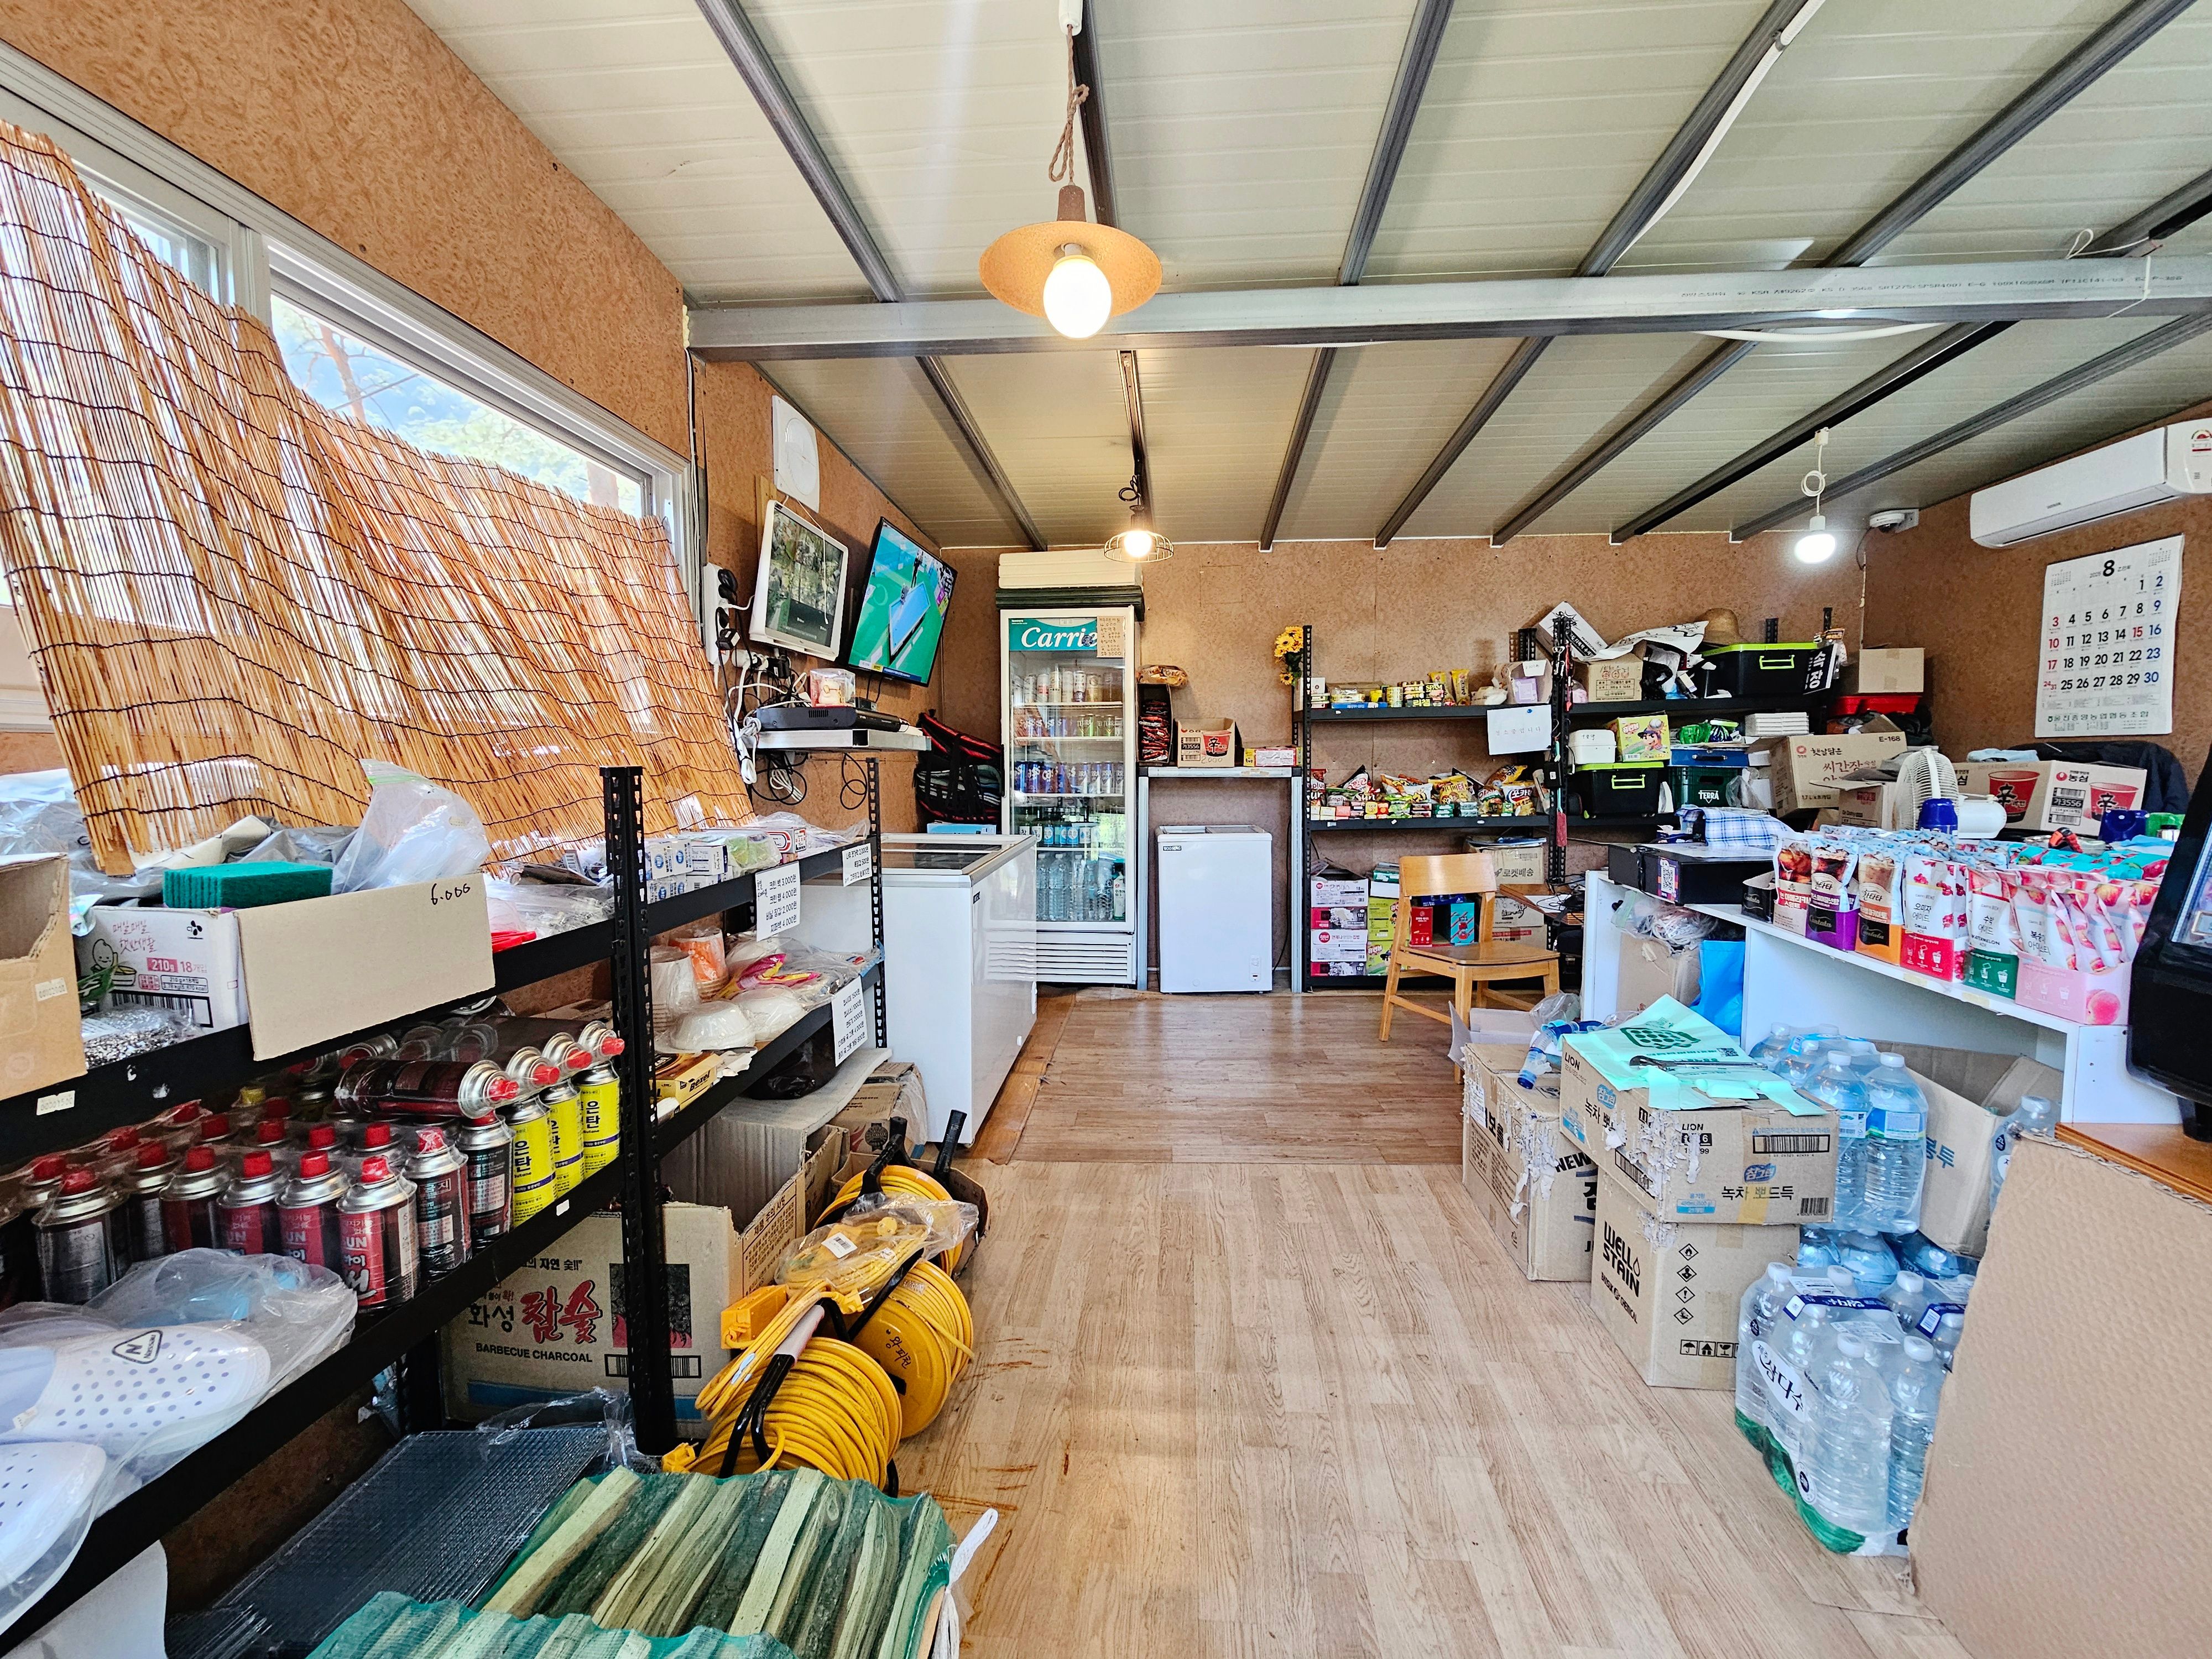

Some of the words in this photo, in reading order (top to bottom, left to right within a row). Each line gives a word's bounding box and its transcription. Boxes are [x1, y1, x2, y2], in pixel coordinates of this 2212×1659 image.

[2103, 559, 2115, 577] 8
[2139, 579, 2145, 591] 1
[2155, 575, 2163, 587] 2
[2052, 616, 2059, 627] 3
[2068, 614, 2076, 624] 4
[2085, 611, 2092, 622] 5
[2101, 608, 2109, 619] 6
[2119, 606, 2127, 617] 7
[2136, 602, 2143, 614] 8
[2153, 599, 2161, 612] 9
[1021, 627, 1098, 648] Carrie
[2048, 638, 2060, 649] 10
[2066, 636, 2074, 647] 11
[2081, 634, 2092, 644] 12
[2097, 631, 2109, 643] 13
[2114, 628, 2126, 640] 14
[2132, 626, 2143, 638] 15
[2149, 623, 2162, 636] 16
[2047, 659, 2058, 670] 17
[2063, 658, 2074, 669] 18
[2079, 655, 2090, 667] 19
[2094, 653, 2109, 665] 20
[2112, 651, 2124, 664] 21
[2128, 649, 2142, 661] 22
[2146, 647, 2161, 660] 23
[1425, 684, 1444, 692] SPAM
[2060, 679, 2073, 691] 25
[2076, 677, 2089, 689] 26
[2093, 676, 2106, 688] 27
[2109, 674, 2123, 686] 28
[2126, 673, 2141, 685] 29
[2143, 671, 2159, 684] 30
[1208, 737, 1221, 754] 辛
[1822, 760, 1864, 774] 씨간장
[2068, 774, 2089, 782] 농심
[1698, 791, 1719, 800] TERRA
[2053, 797, 2082, 807] 가3556
[1503, 868, 1534, 878] 로켓배송
[769, 880, 777, 890] 크린
[431, 883, 471, 905] 6.000
[769, 894, 778, 905] 크린
[1863, 889, 1883, 902] 칸타타
[1913, 902, 1932, 912] 오미자
[1912, 912, 1931, 923] 에이드
[1983, 915, 1995, 925] 수박
[112, 920, 150, 935] 매일매일
[1978, 924, 1994, 935] 에이드
[151, 959, 175, 972] 210g
[1564, 1051, 1580, 1072] LION
[688, 1070, 711, 1093] Bexel
[1584, 1098, 1601, 1124] 녹차
[1556, 1151, 1592, 1173] NEW
[1721, 1186, 1749, 1201] 녹차
[1752, 1186, 1794, 1201] 뽀드득
[754, 1218, 764, 1236] 제품
[765, 1207, 775, 1223] 주의
[346, 1237, 367, 1248] UN
[1604, 1220, 1633, 1271] WELL
[539, 1258, 561, 1271] 자연
[1603, 1242, 1640, 1298] STAIN
[468, 1303, 514, 1333] 화성
[476, 1343, 530, 1359] BARBECUE
[532, 1349, 593, 1363] CHARCOAL
[885, 1336, 912, 1370] 왕피천
[1760, 1352, 1805, 1413] 삼다수
